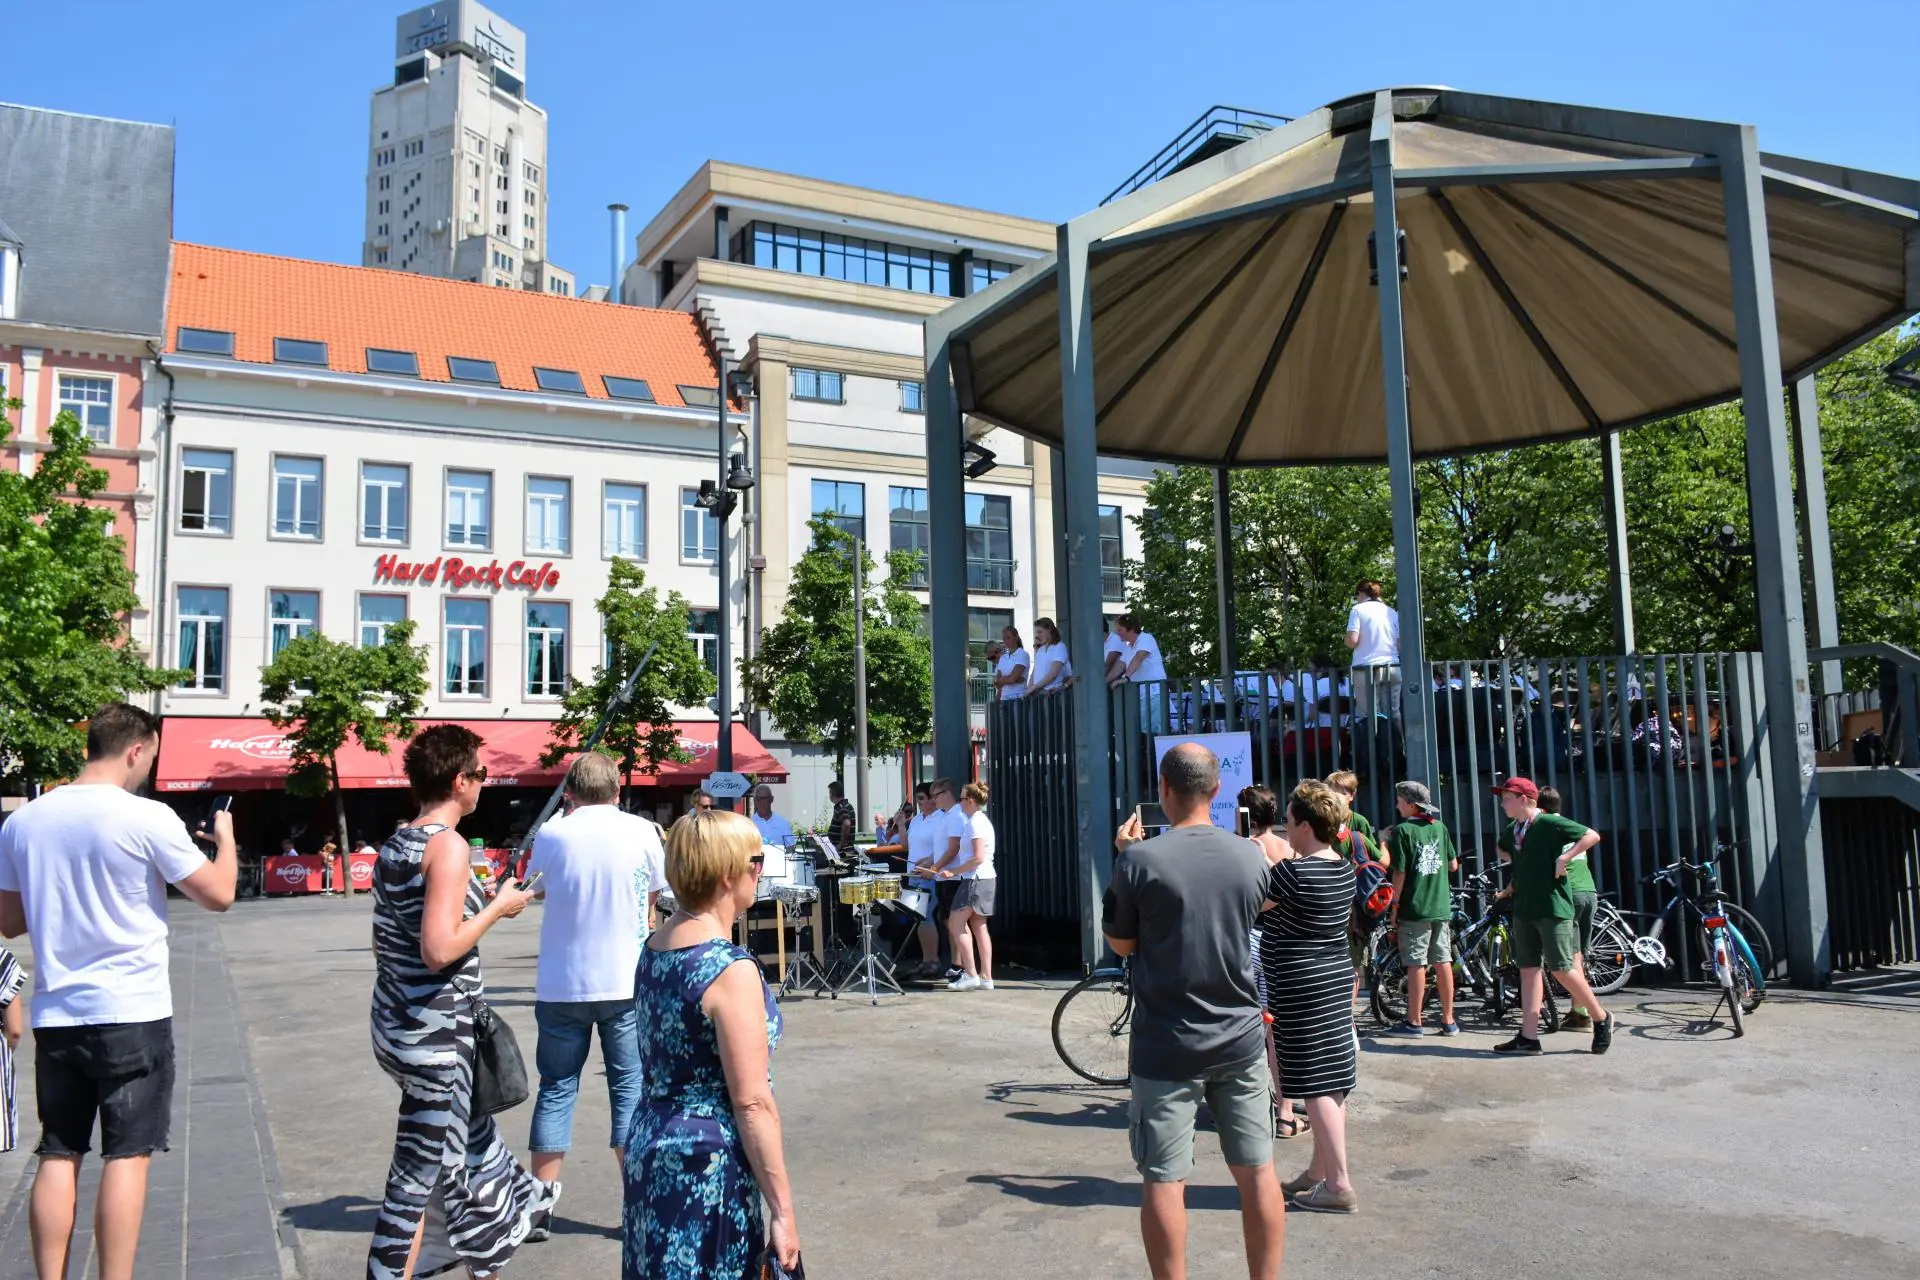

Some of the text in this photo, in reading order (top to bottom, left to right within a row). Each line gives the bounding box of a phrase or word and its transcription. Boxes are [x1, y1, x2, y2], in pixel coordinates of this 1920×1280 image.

[376, 554, 560, 590] Hard Rock Cafe
[209, 739, 275, 749] Hard
